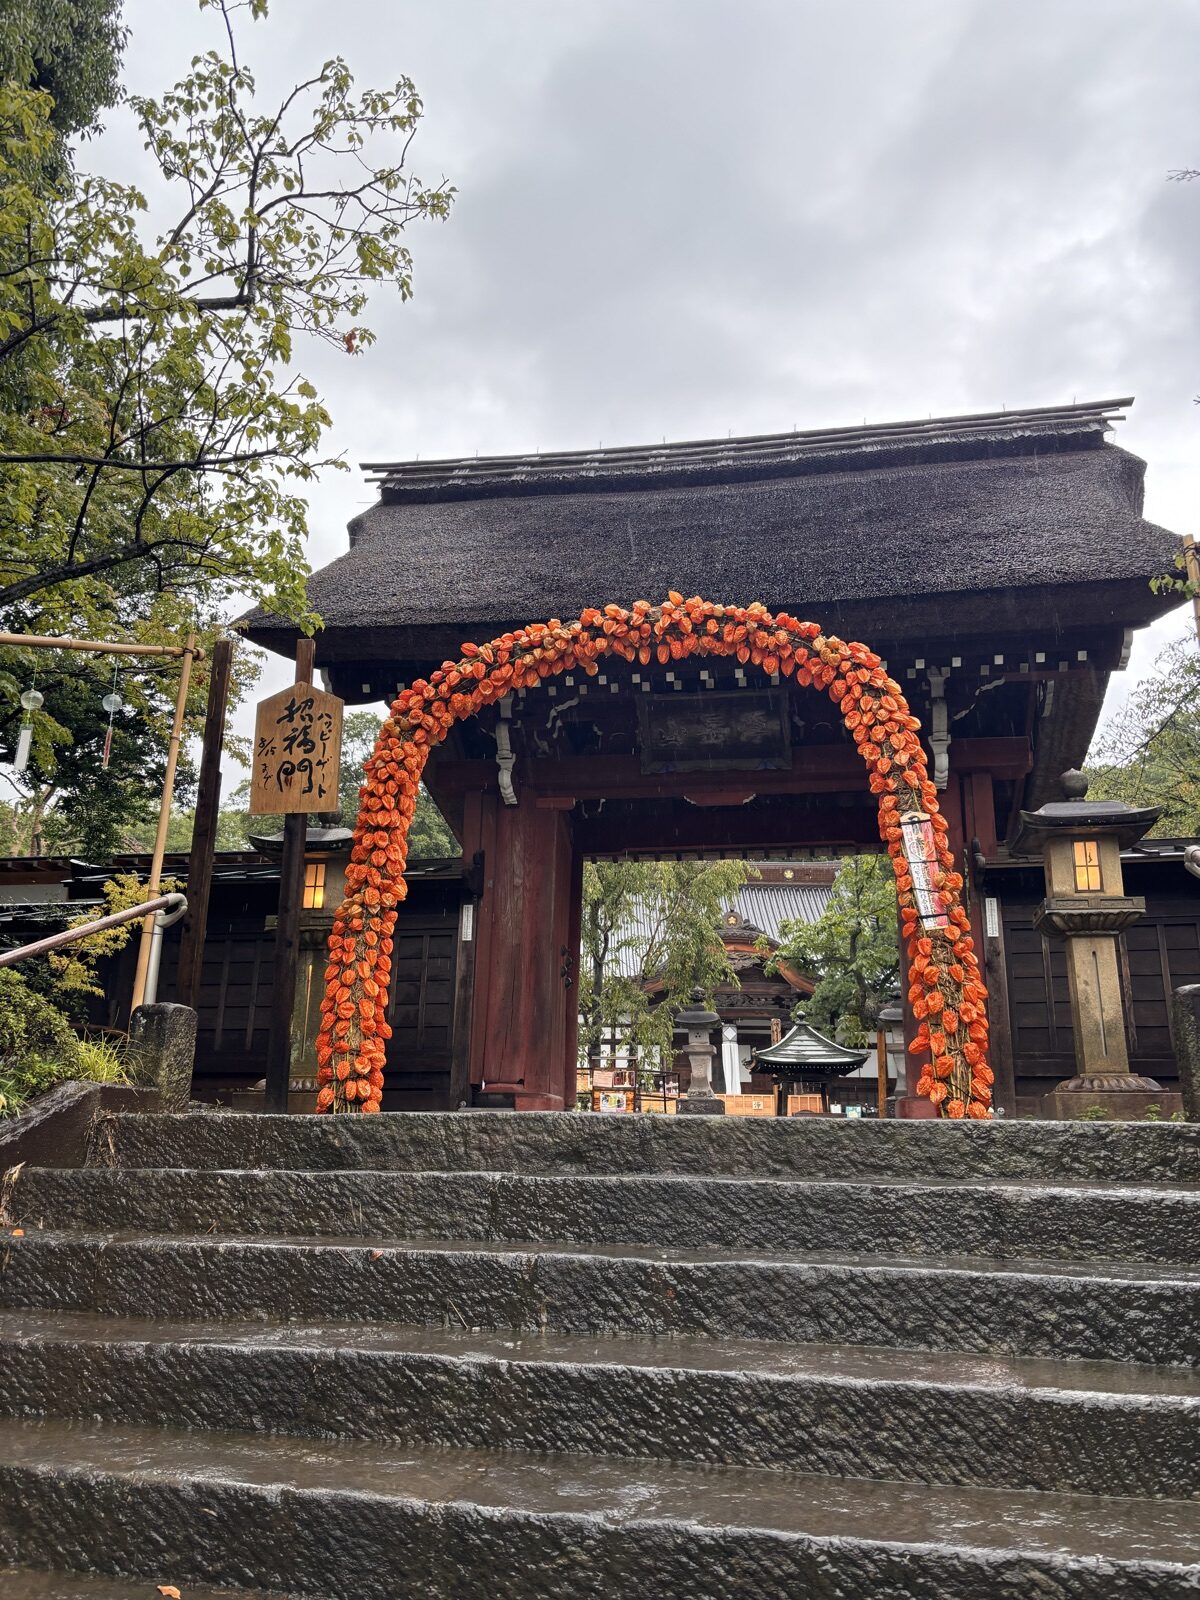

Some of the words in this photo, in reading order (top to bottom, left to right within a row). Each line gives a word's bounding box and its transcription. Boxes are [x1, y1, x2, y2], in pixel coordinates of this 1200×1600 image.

[276, 697, 316, 795] 招福門
[316, 712, 333, 798] ハッピーゲート
